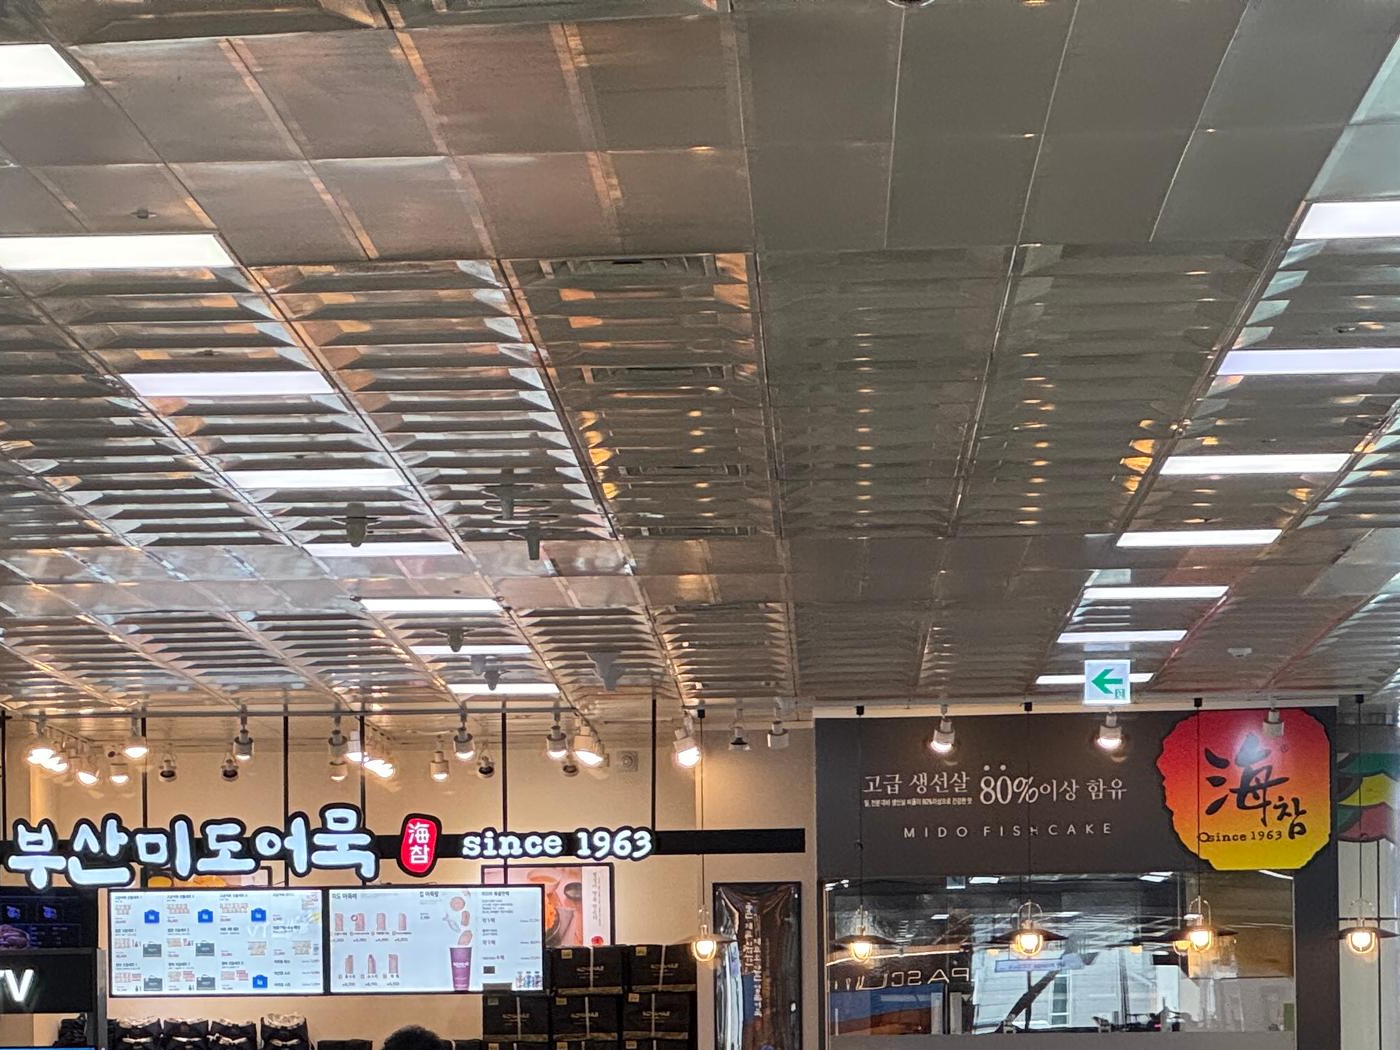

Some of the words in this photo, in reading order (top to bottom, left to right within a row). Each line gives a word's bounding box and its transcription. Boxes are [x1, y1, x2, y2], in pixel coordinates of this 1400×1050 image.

[863, 774, 903, 795] 고급
[909, 771, 971, 795] 생선살
[980, 774, 1080, 805] 80%이상
[1086, 777, 1127, 802] 함유
[462, 831, 563, 857] since
[576, 829, 652, 858] 1963
[903, 825, 969, 838] MIDO
[1250, 830, 1283, 842] 1963
[6, 807, 377, 890] 부산미도어묵
